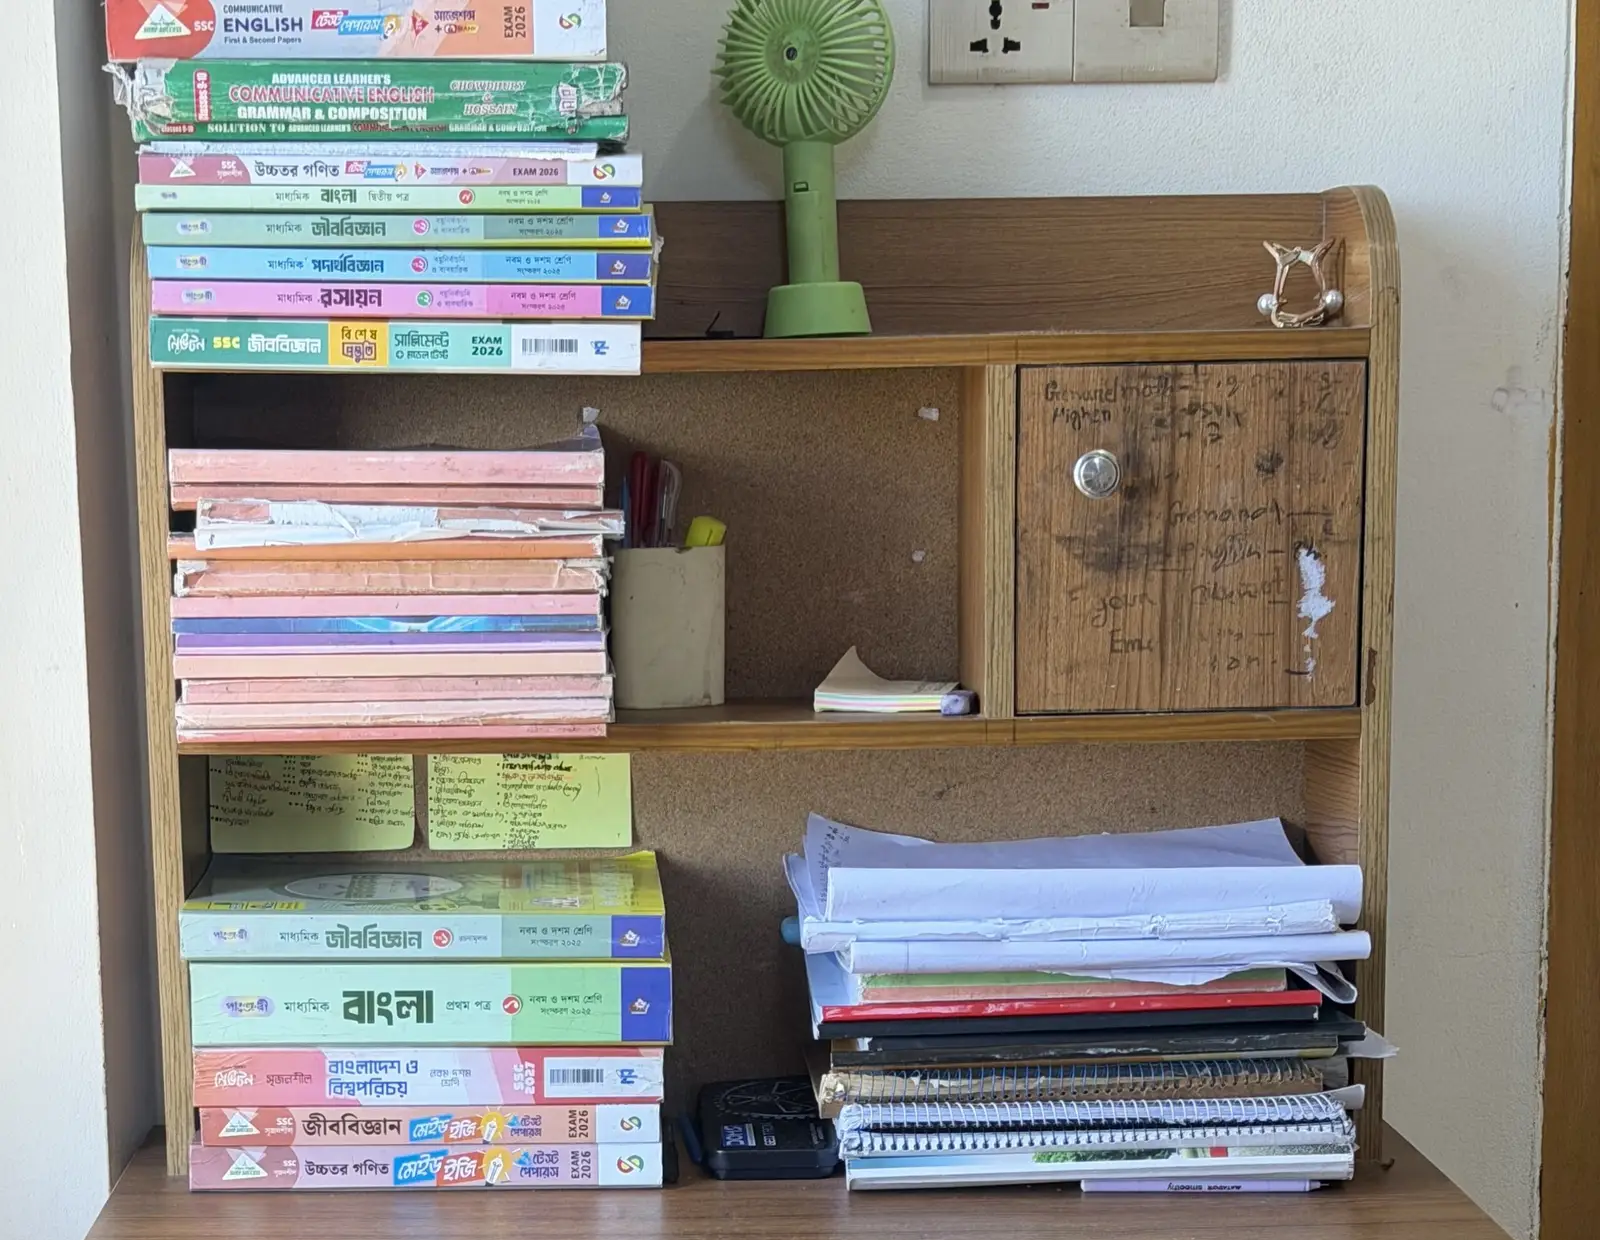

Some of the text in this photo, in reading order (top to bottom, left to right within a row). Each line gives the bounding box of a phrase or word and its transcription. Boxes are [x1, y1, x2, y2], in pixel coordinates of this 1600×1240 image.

[223, 5, 283, 14] COMMUNICATIVE
[194, 20, 214, 32] SSC
[223, 17, 303, 33] ENGLISH
[504, 6, 514, 39] EXAM
[515, 6, 526, 38] 2026
[224, 36, 240, 44] First
[249, 36, 276, 44] Second
[278, 36, 302, 45] Papers
[272, 72, 391, 85] ADVANCED LEARNER'S
[229, 85, 435, 104] COMMUNICATIVE ENGLISH
[237, 106, 427, 120] GRAMMAR & COMPOSITION
[463, 103, 518, 116] HOSSAIN
[207, 123, 266, 133] SOLUTION
[270, 123, 285, 133] TO
[221, 161, 236, 169] SSC
[254, 160, 340, 178] উচ্চতর গণিত
[513, 168, 559, 176] EXAM 2026
[320, 189, 357, 204] বাংলা
[311, 216, 387, 237] জীববিজ্ঞান
[311, 253, 385, 274] পদার্থবিজ্ঞান
[320, 288, 382, 308] রসায়ন
[213, 337, 241, 349] SSC
[248, 333, 322, 354] জীববিজ্ঞান
[471, 336, 503, 345] EXAM
[471, 346, 503, 356] 2026
[279, 930, 320, 943] মাধ্যমিক
[325, 923, 423, 950] জীববিজ্ঞান
[529, 994, 548, 1004] নবম
[561, 994, 580, 1004] দশম
[583, 992, 603, 1004] শ্রেণি
[284, 997, 331, 1014] মাধ্যমিক
[342, 989, 434, 1026] বাংলা
[446, 1001, 470, 1012] প্রথম
[475, 1000, 492, 1012] পত্র
[328, 1060, 418, 1076] বাংলাদেশ ও
[266, 1072, 313, 1088] সৃজনশীল
[513, 1063, 524, 1092] SSC
[524, 1061, 536, 1095] 2027
[328, 1078, 408, 1098] বিশ্বপরিচয়
[276, 1117, 293, 1126] SSC
[302, 1112, 402, 1137] জীববিজ্ঞান
[569, 1109, 578, 1138] EXAM
[579, 1109, 589, 1138] 2026
[283, 1159, 297, 1167] SSC
[397, 1154, 442, 1179] মেইড
[532, 1151, 560, 1165] টেস্ট
[571, 1150, 580, 1179] EXAM
[581, 1150, 592, 1179] 2026
[305, 1159, 390, 1177] উচ্চতর গণিত
[519, 1165, 560, 1179] পেপারস
